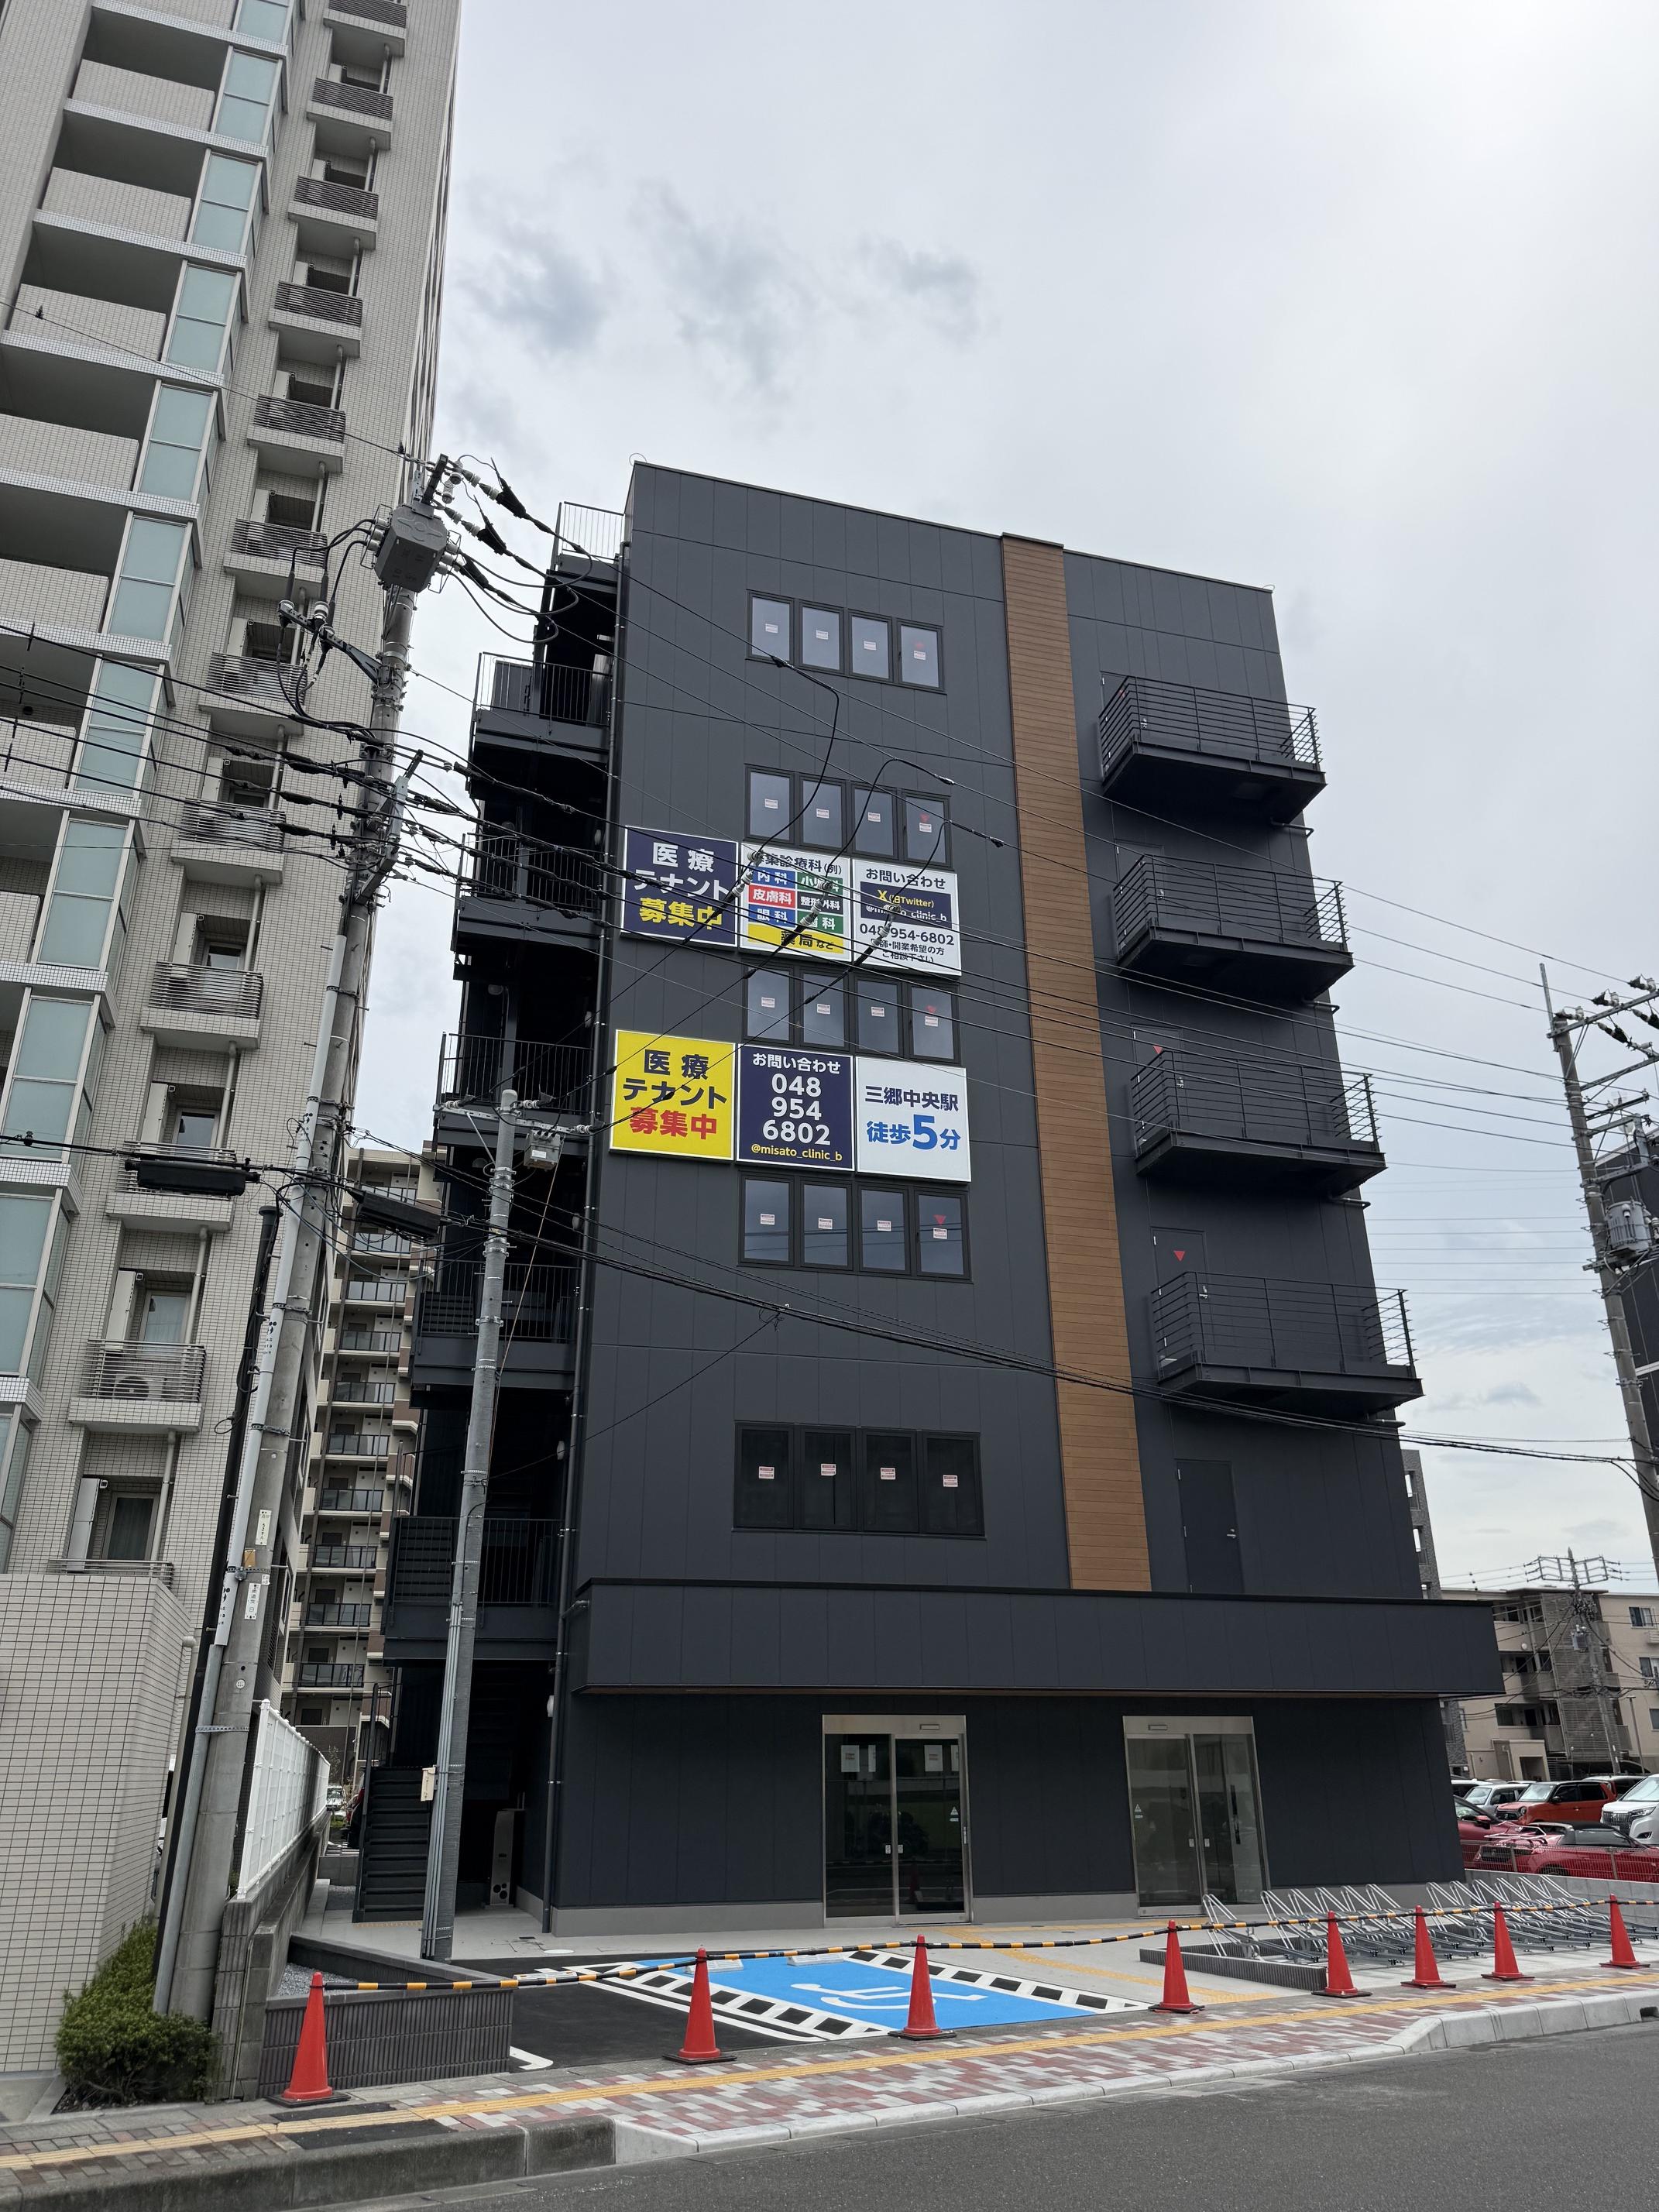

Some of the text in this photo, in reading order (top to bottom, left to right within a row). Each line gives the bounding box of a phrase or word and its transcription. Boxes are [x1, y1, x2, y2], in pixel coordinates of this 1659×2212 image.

[653, 842, 714, 872] 医療
[634, 869, 730, 901] テナント
[757, 869, 788, 884] 内科
[866, 868, 946, 889] お問い合わせ
[753, 889, 792, 905] 皮膚科
[640, 898, 723, 929] 募集中
[644, 1049, 709, 1080] 医療
[753, 1053, 840, 1074] お問い合わせ
[623, 1078, 726, 1109] テナント
[771, 1073, 822, 1097] 048
[865, 1085, 959, 1111] 三郷中央駅
[771, 1097, 822, 1121] 954
[630, 1107, 716, 1140] 募集中
[763, 1119, 830, 1145] 6802
[866, 1114, 960, 1150] 徒歩5分
[751, 1143, 843, 1161] @misato_clinic_b
